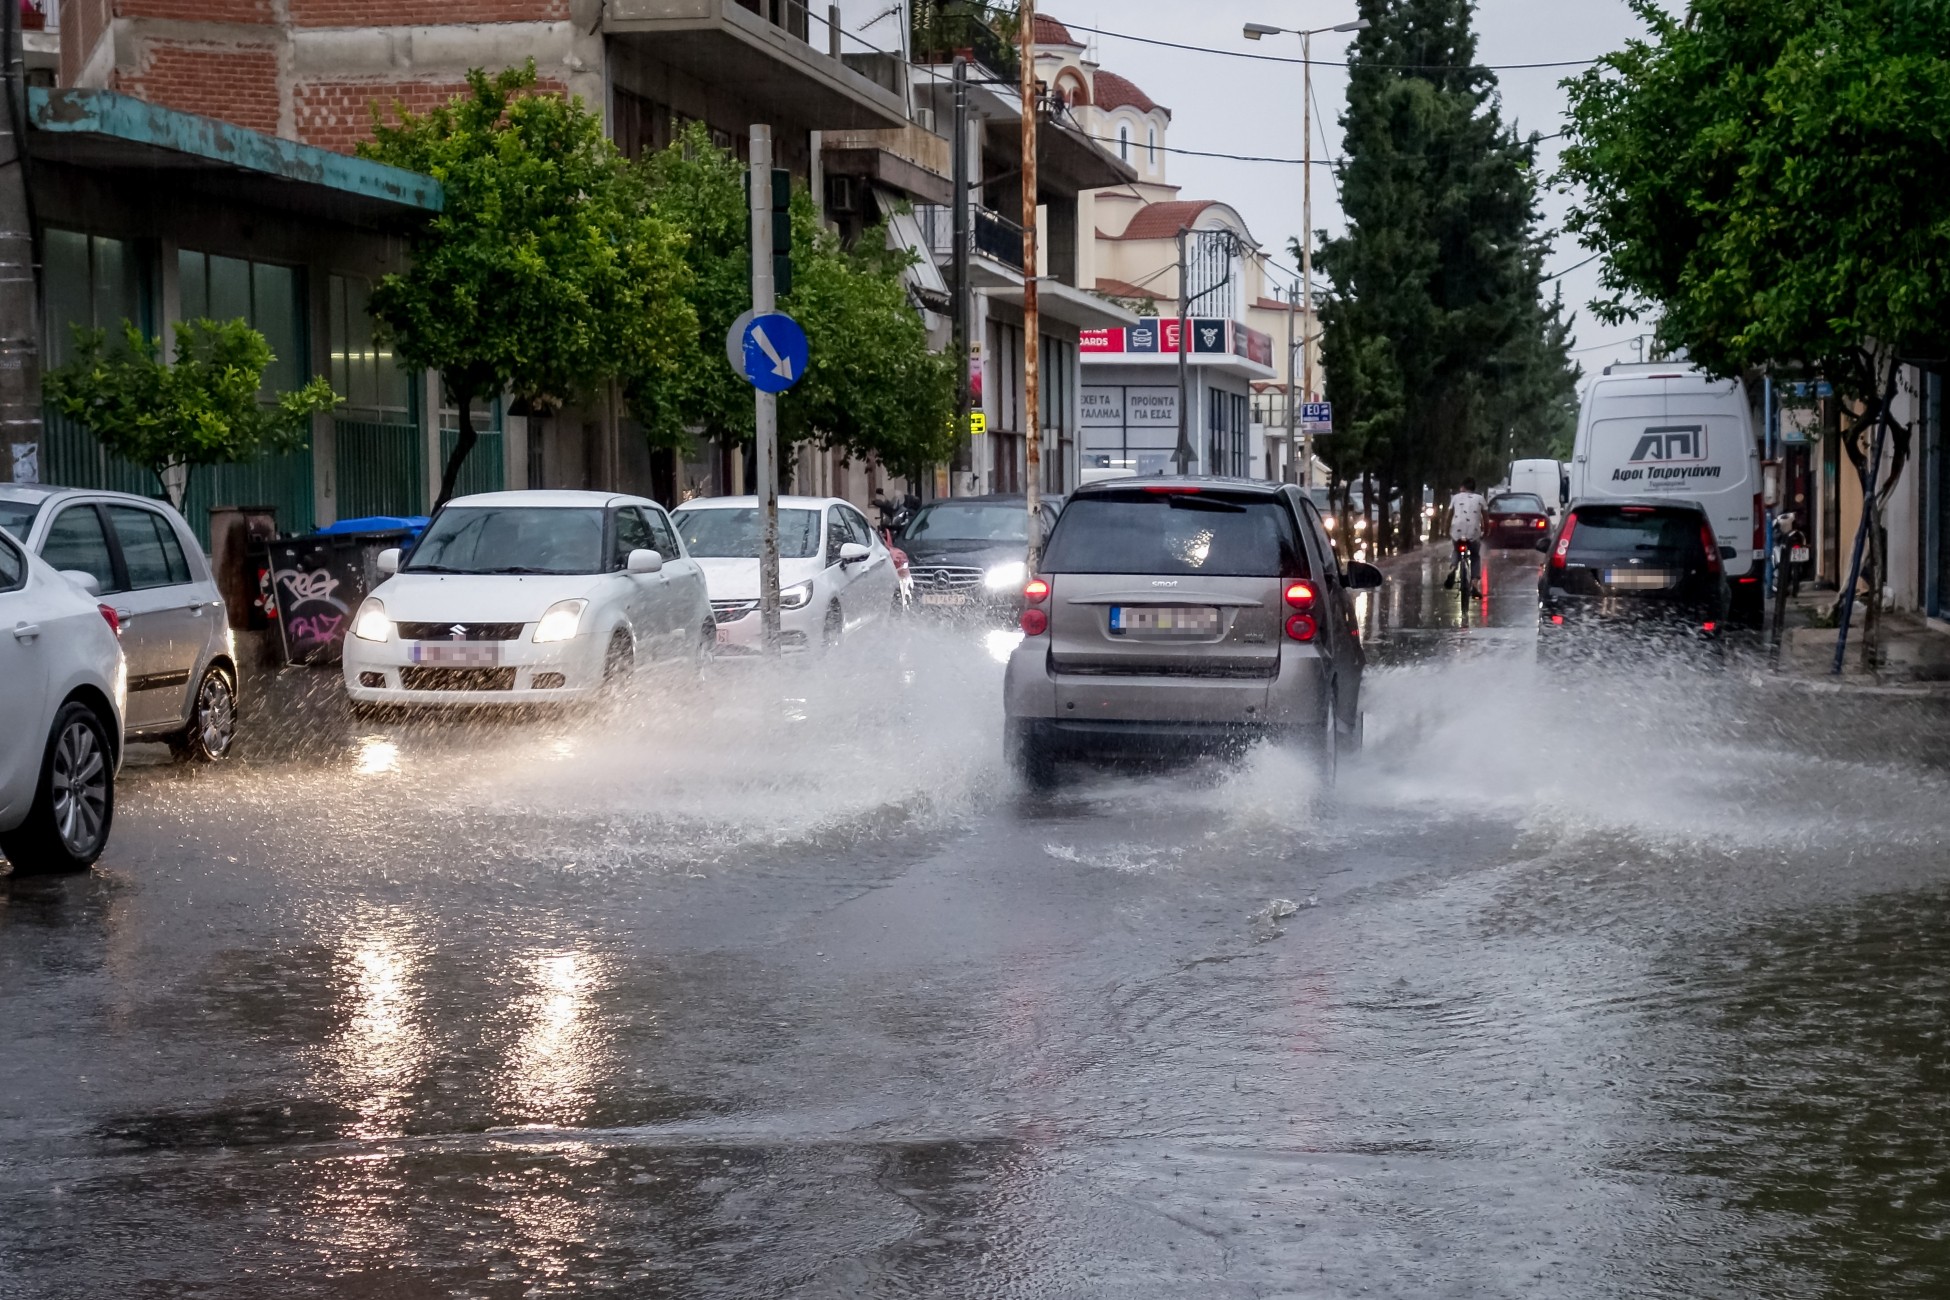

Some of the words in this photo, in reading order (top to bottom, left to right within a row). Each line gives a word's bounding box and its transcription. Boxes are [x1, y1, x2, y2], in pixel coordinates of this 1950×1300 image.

[1099, 395, 1110, 404] ΤΑ
[1134, 409, 1148, 419] ΓΙΑ
[1150, 409, 1172, 419] ΕΣΑΣ
